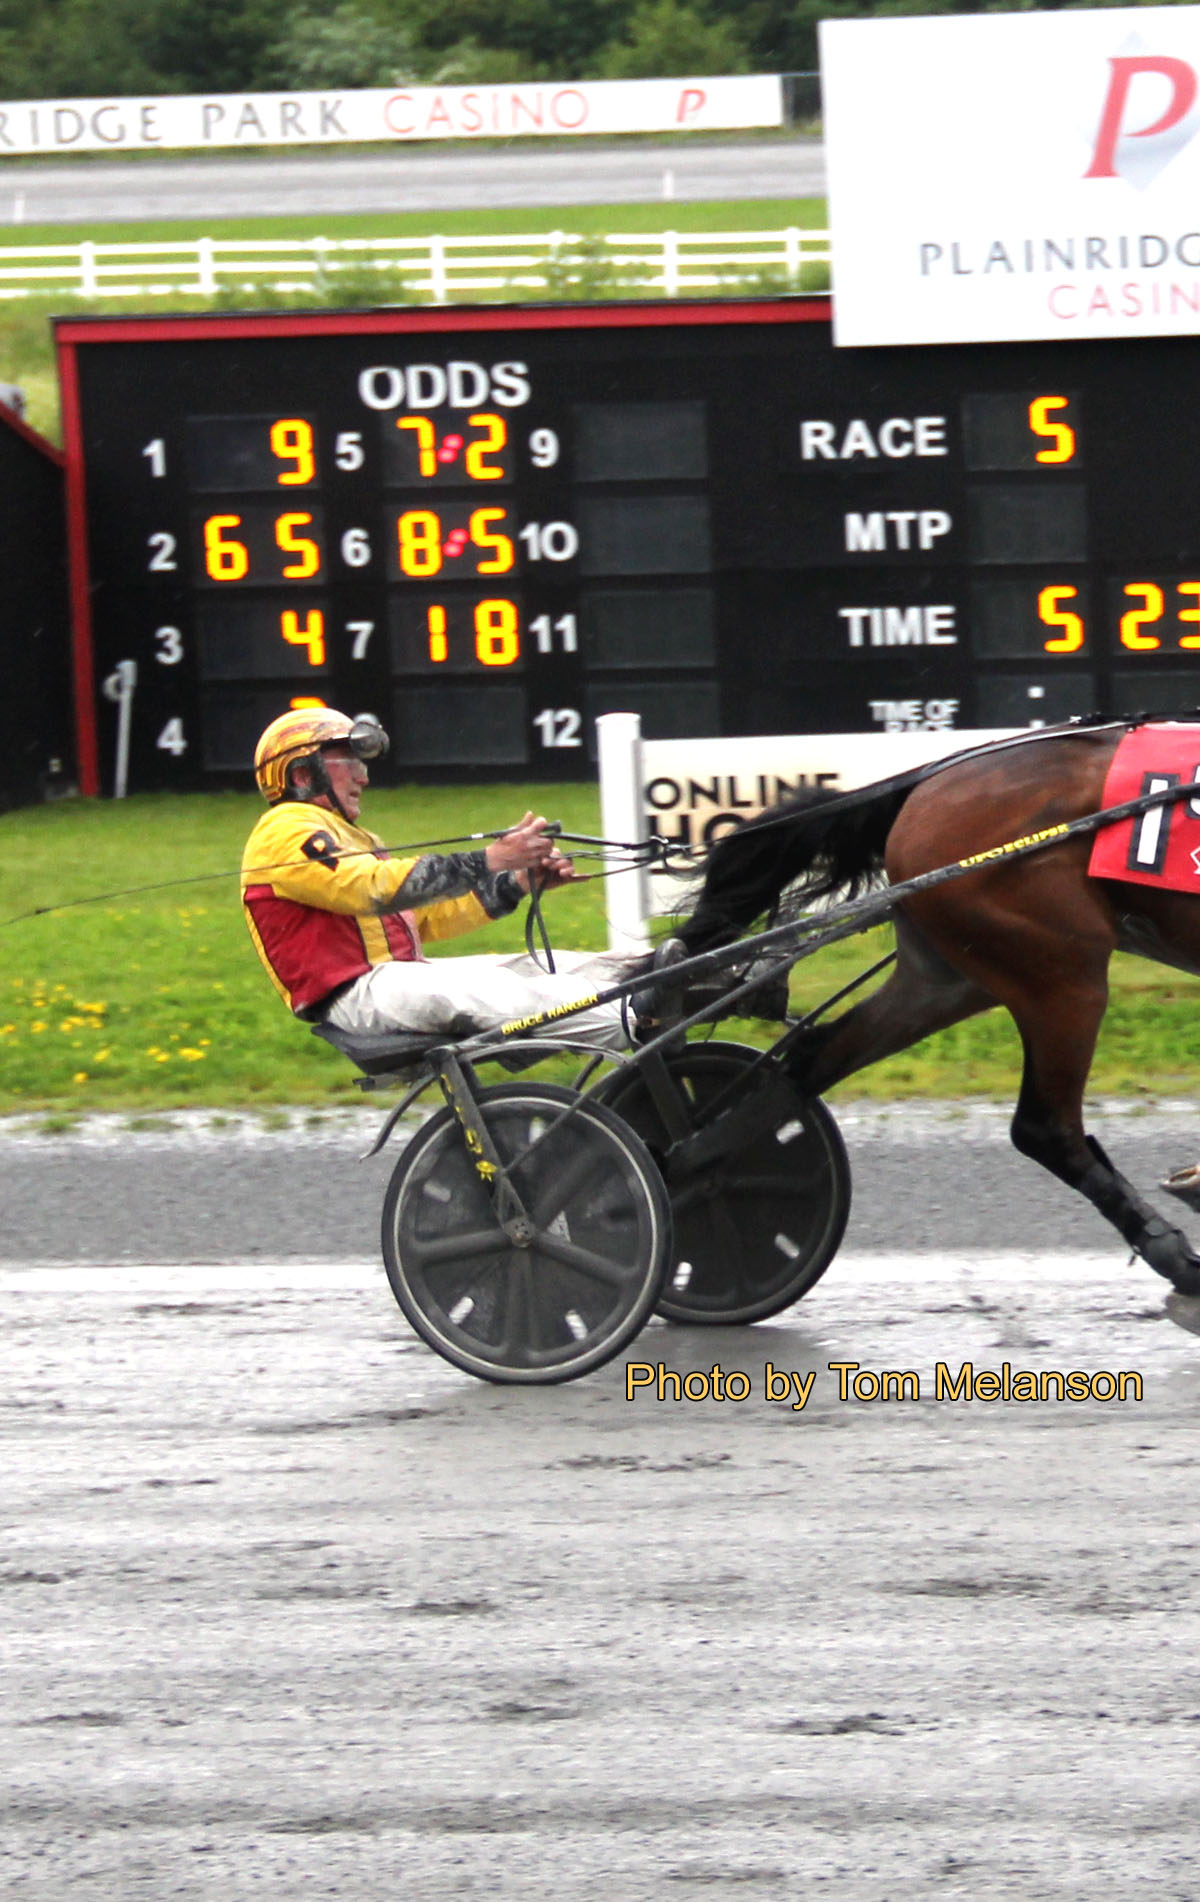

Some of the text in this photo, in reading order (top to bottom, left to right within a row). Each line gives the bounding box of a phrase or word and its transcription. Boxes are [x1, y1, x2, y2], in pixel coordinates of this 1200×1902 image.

[202, 100, 347, 140] PARK
[383, 89, 590, 134] CASINO
[359, 361, 532, 411] ODDS
[530, 429, 560, 468] 9
[799, 416, 949, 461] RACE
[1028, 396, 1076, 464] 5
[143, 440, 166, 478] 1
[270, 419, 316, 486] 9
[336, 432, 365, 472] 5
[149, 533, 177, 571] 2
[342, 530, 371, 567] 6
[520, 522, 580, 563] 10
[845, 511, 953, 553] MTP
[281, 609, 325, 667] 4
[530, 615, 578, 654] 11
[839, 606, 959, 648] TIME
[1038, 585, 1085, 655] 5
[157, 627, 183, 665] 3
[347, 622, 375, 660] 7
[534, 709, 583, 749] 12
[924, 699, 960, 720] OF
[157, 718, 188, 756] 4
